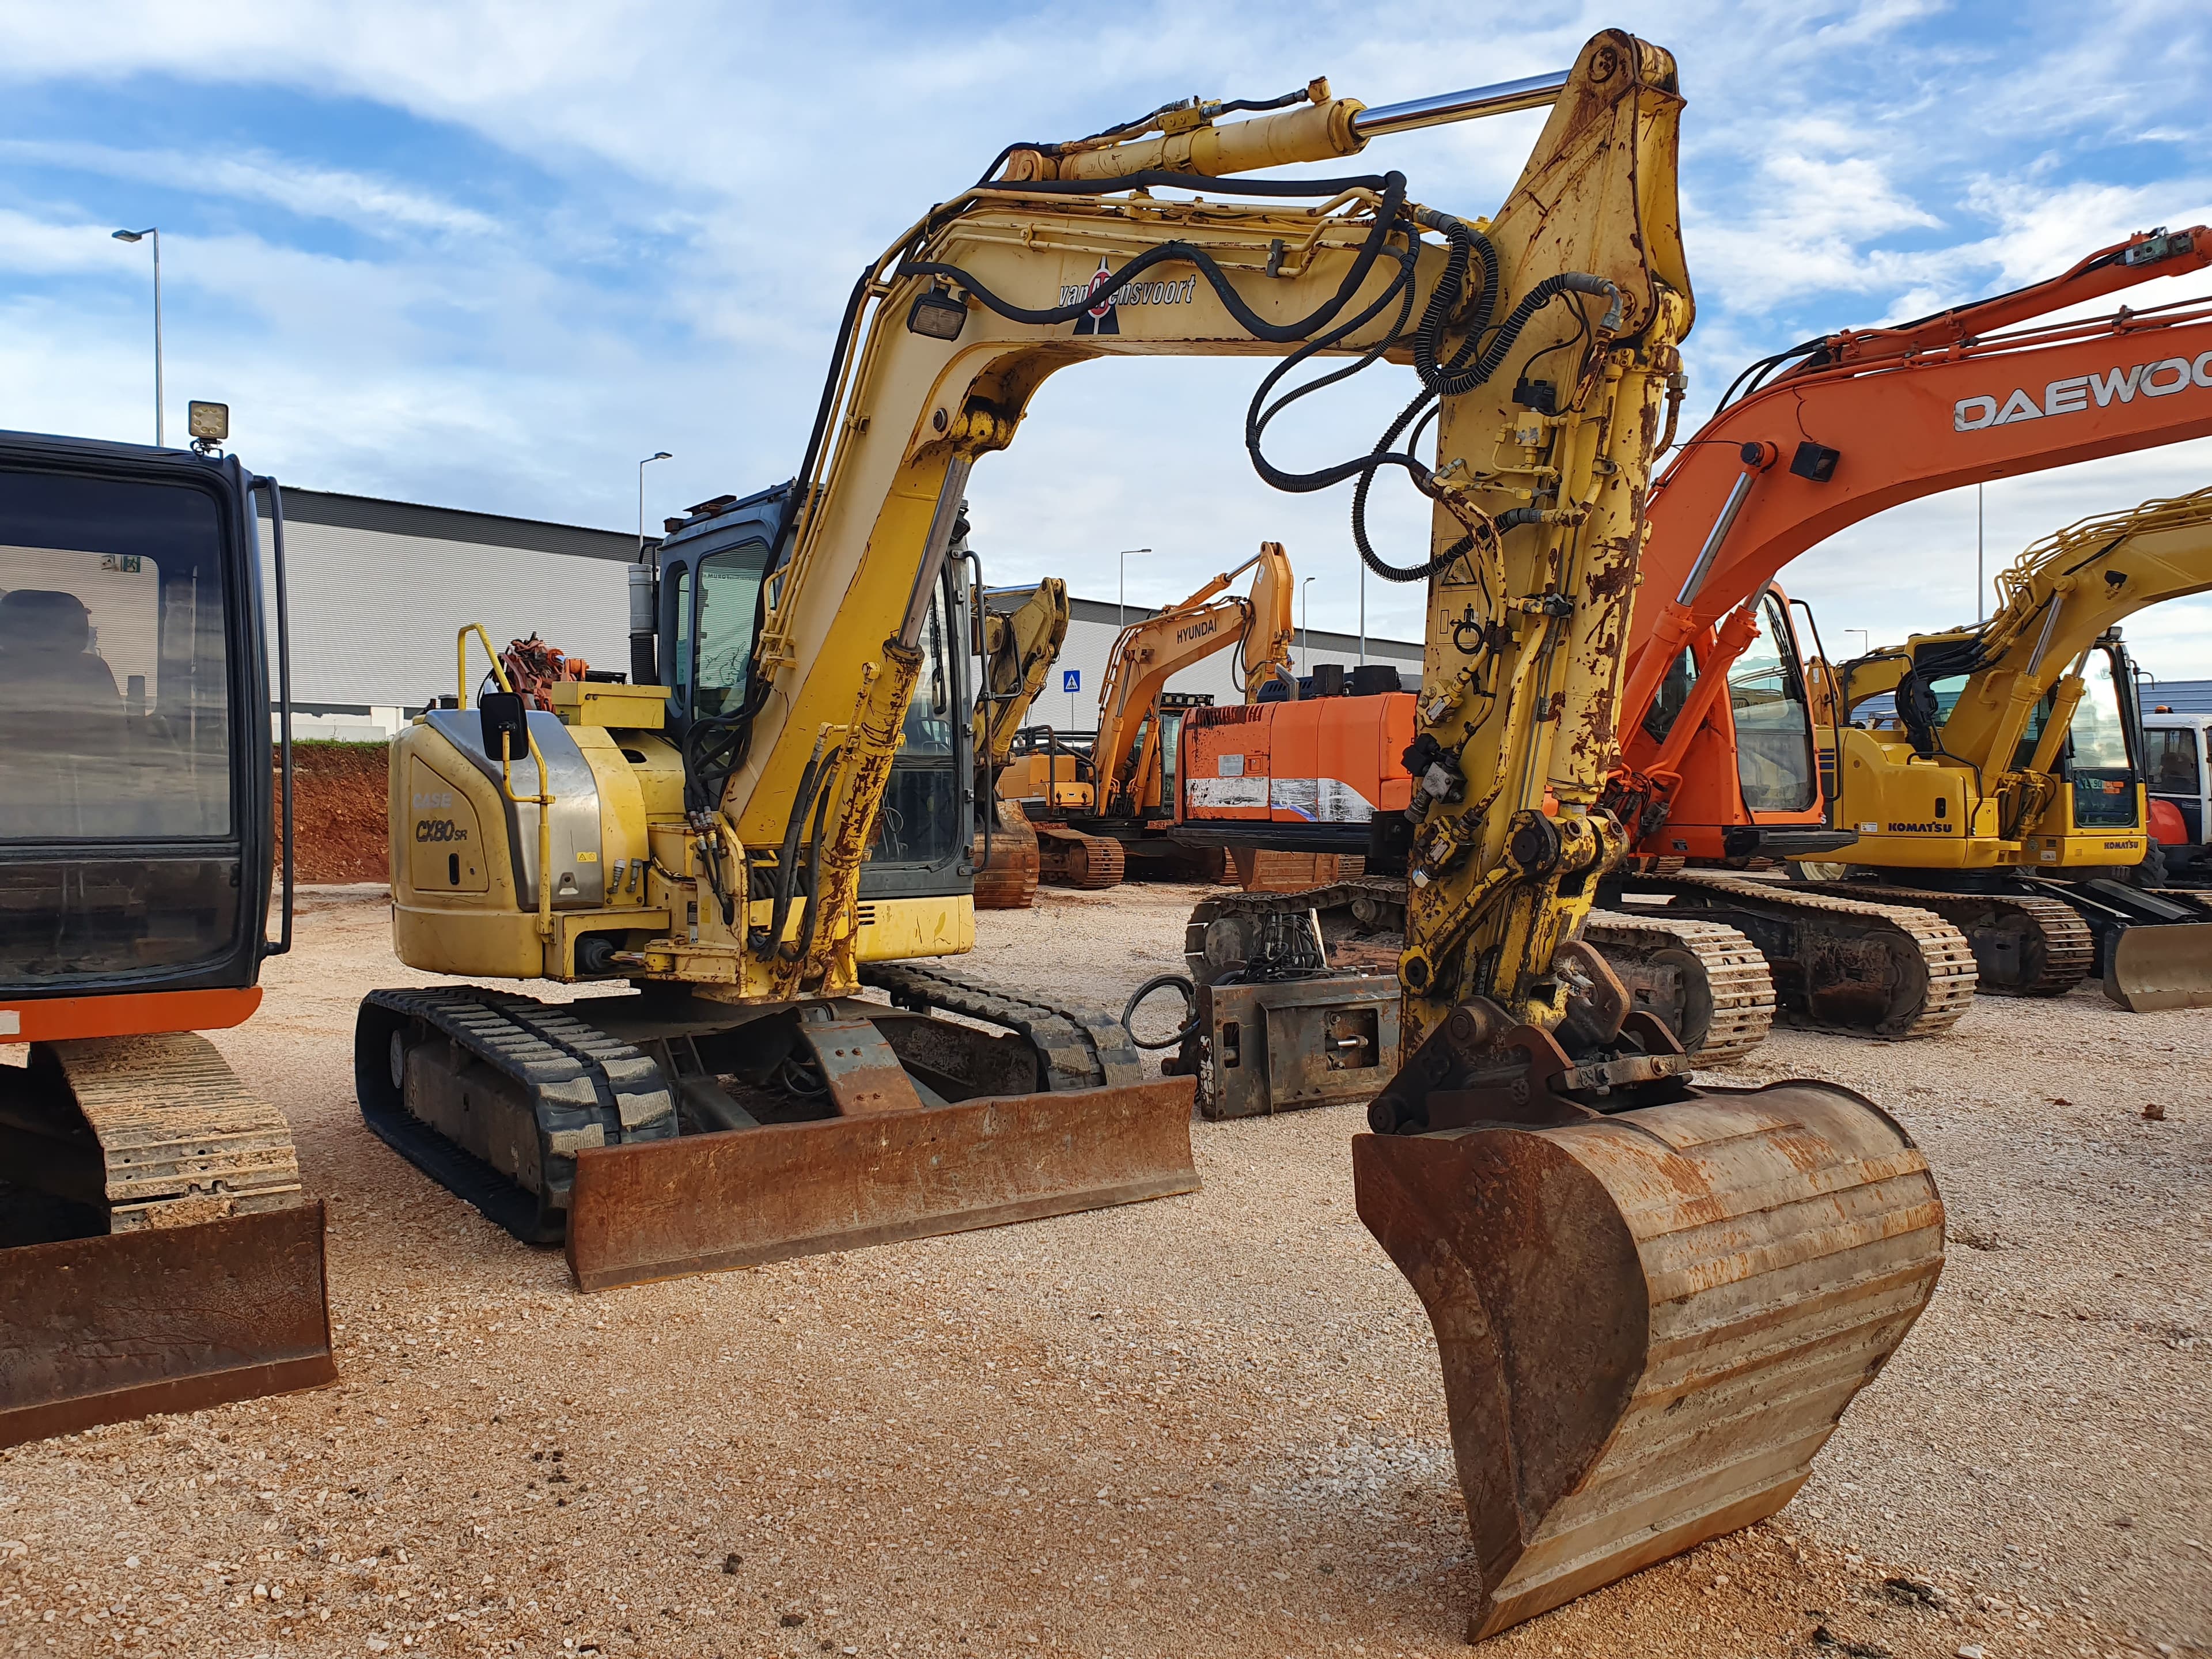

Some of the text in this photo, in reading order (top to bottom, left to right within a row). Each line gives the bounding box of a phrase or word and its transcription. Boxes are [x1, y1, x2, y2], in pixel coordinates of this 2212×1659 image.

[1177, 618, 1217, 644] HYUNDAI
[413, 793, 452, 808] CASE
[1888, 821, 1952, 833] KOMATSU
[2104, 839, 2139, 850] KOMATSU
